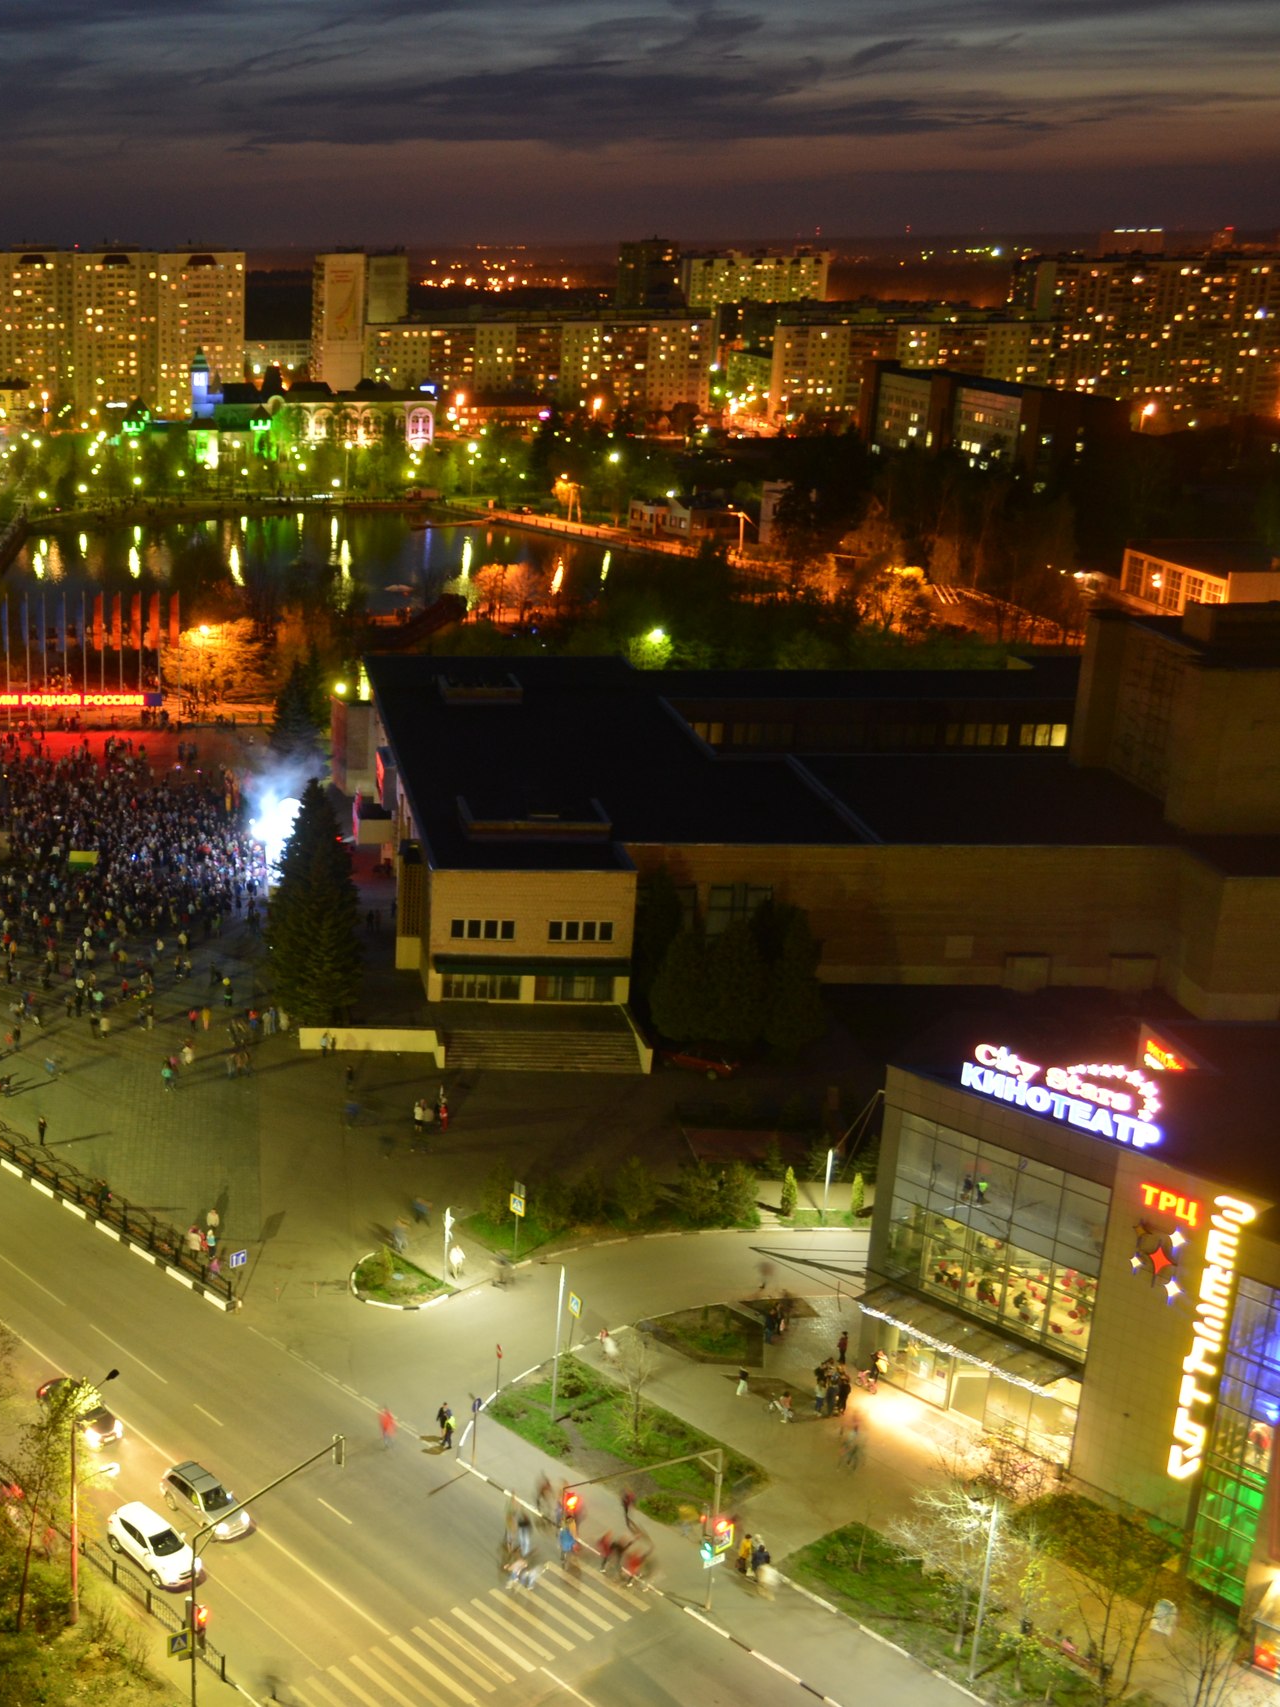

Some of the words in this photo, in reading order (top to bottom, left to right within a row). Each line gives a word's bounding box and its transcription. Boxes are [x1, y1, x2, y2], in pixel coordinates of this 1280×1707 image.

[21, 693, 81, 706] РОДНОЙ
[83, 694, 145, 706] РОССИИ!
[974, 1043, 1041, 1081] City
[960, 1061, 1162, 1149] КИНОТЕАТР
[1141, 1183, 1203, 1227] ТРЦ
